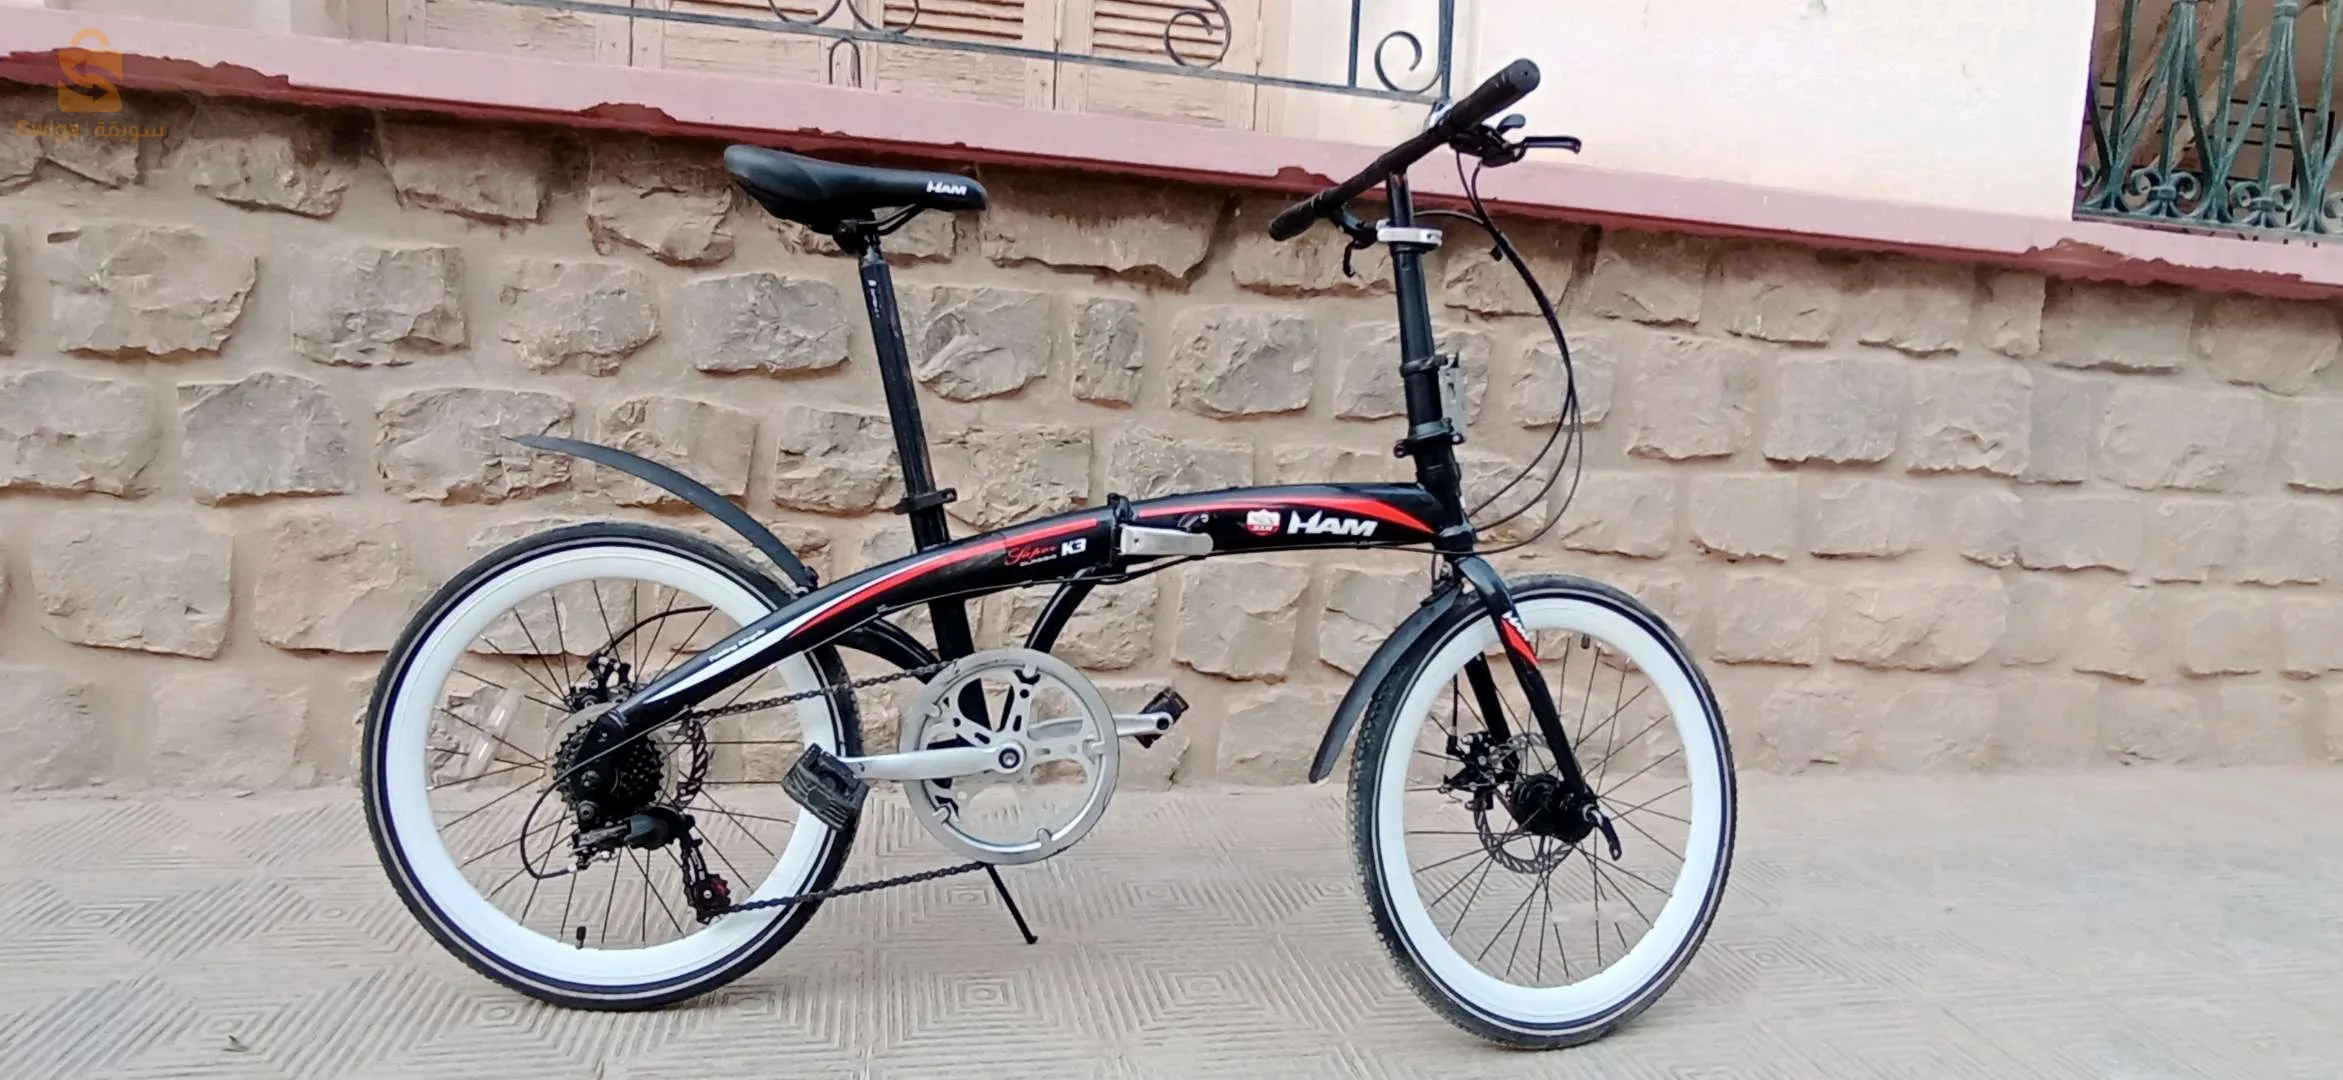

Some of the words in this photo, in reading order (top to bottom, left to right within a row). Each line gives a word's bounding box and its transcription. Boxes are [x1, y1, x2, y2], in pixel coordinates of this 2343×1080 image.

[926, 180, 968, 195] HAM
[1287, 510, 1379, 537] HAM
[1061, 538, 1087, 556] K3
